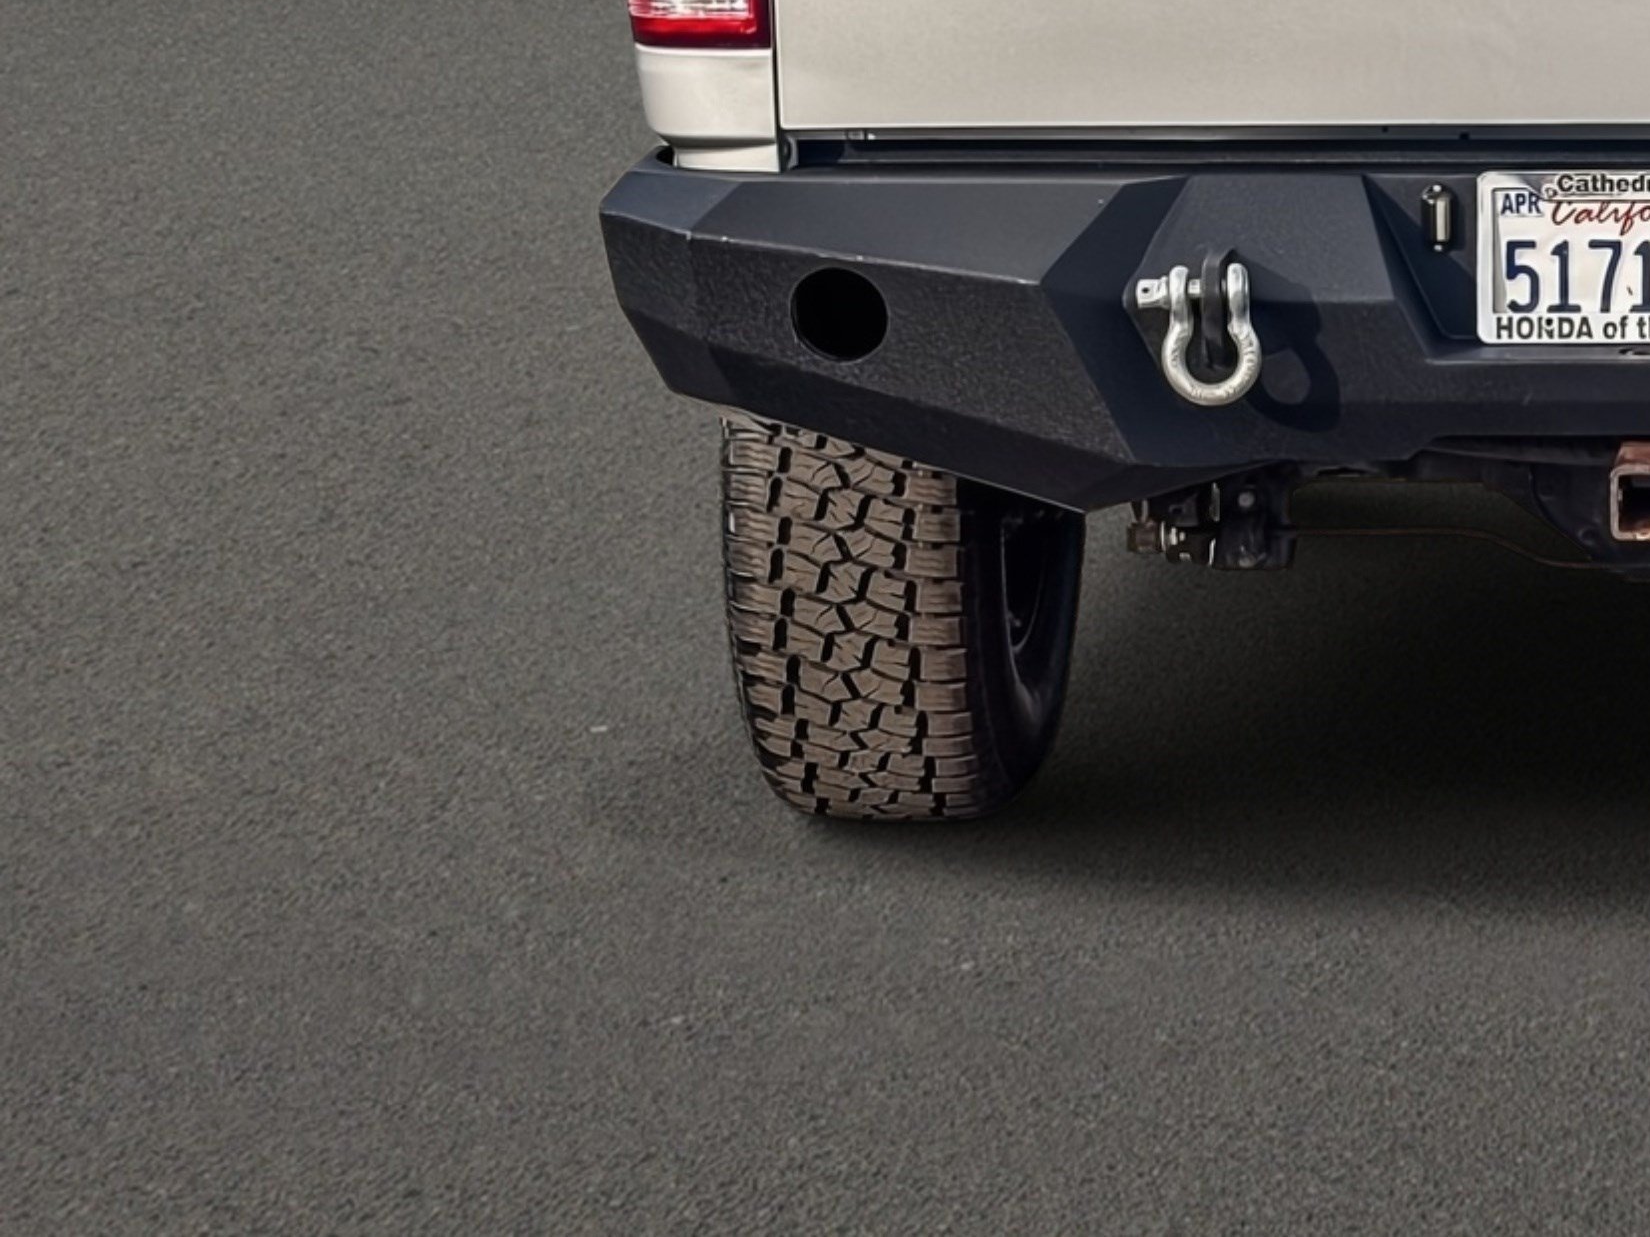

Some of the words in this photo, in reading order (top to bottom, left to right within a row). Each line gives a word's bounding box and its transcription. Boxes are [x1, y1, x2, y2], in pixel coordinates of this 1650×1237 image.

[1501, 193, 1542, 215] APR
[1495, 315, 1594, 340] HONDA
[1602, 315, 1628, 340] of
